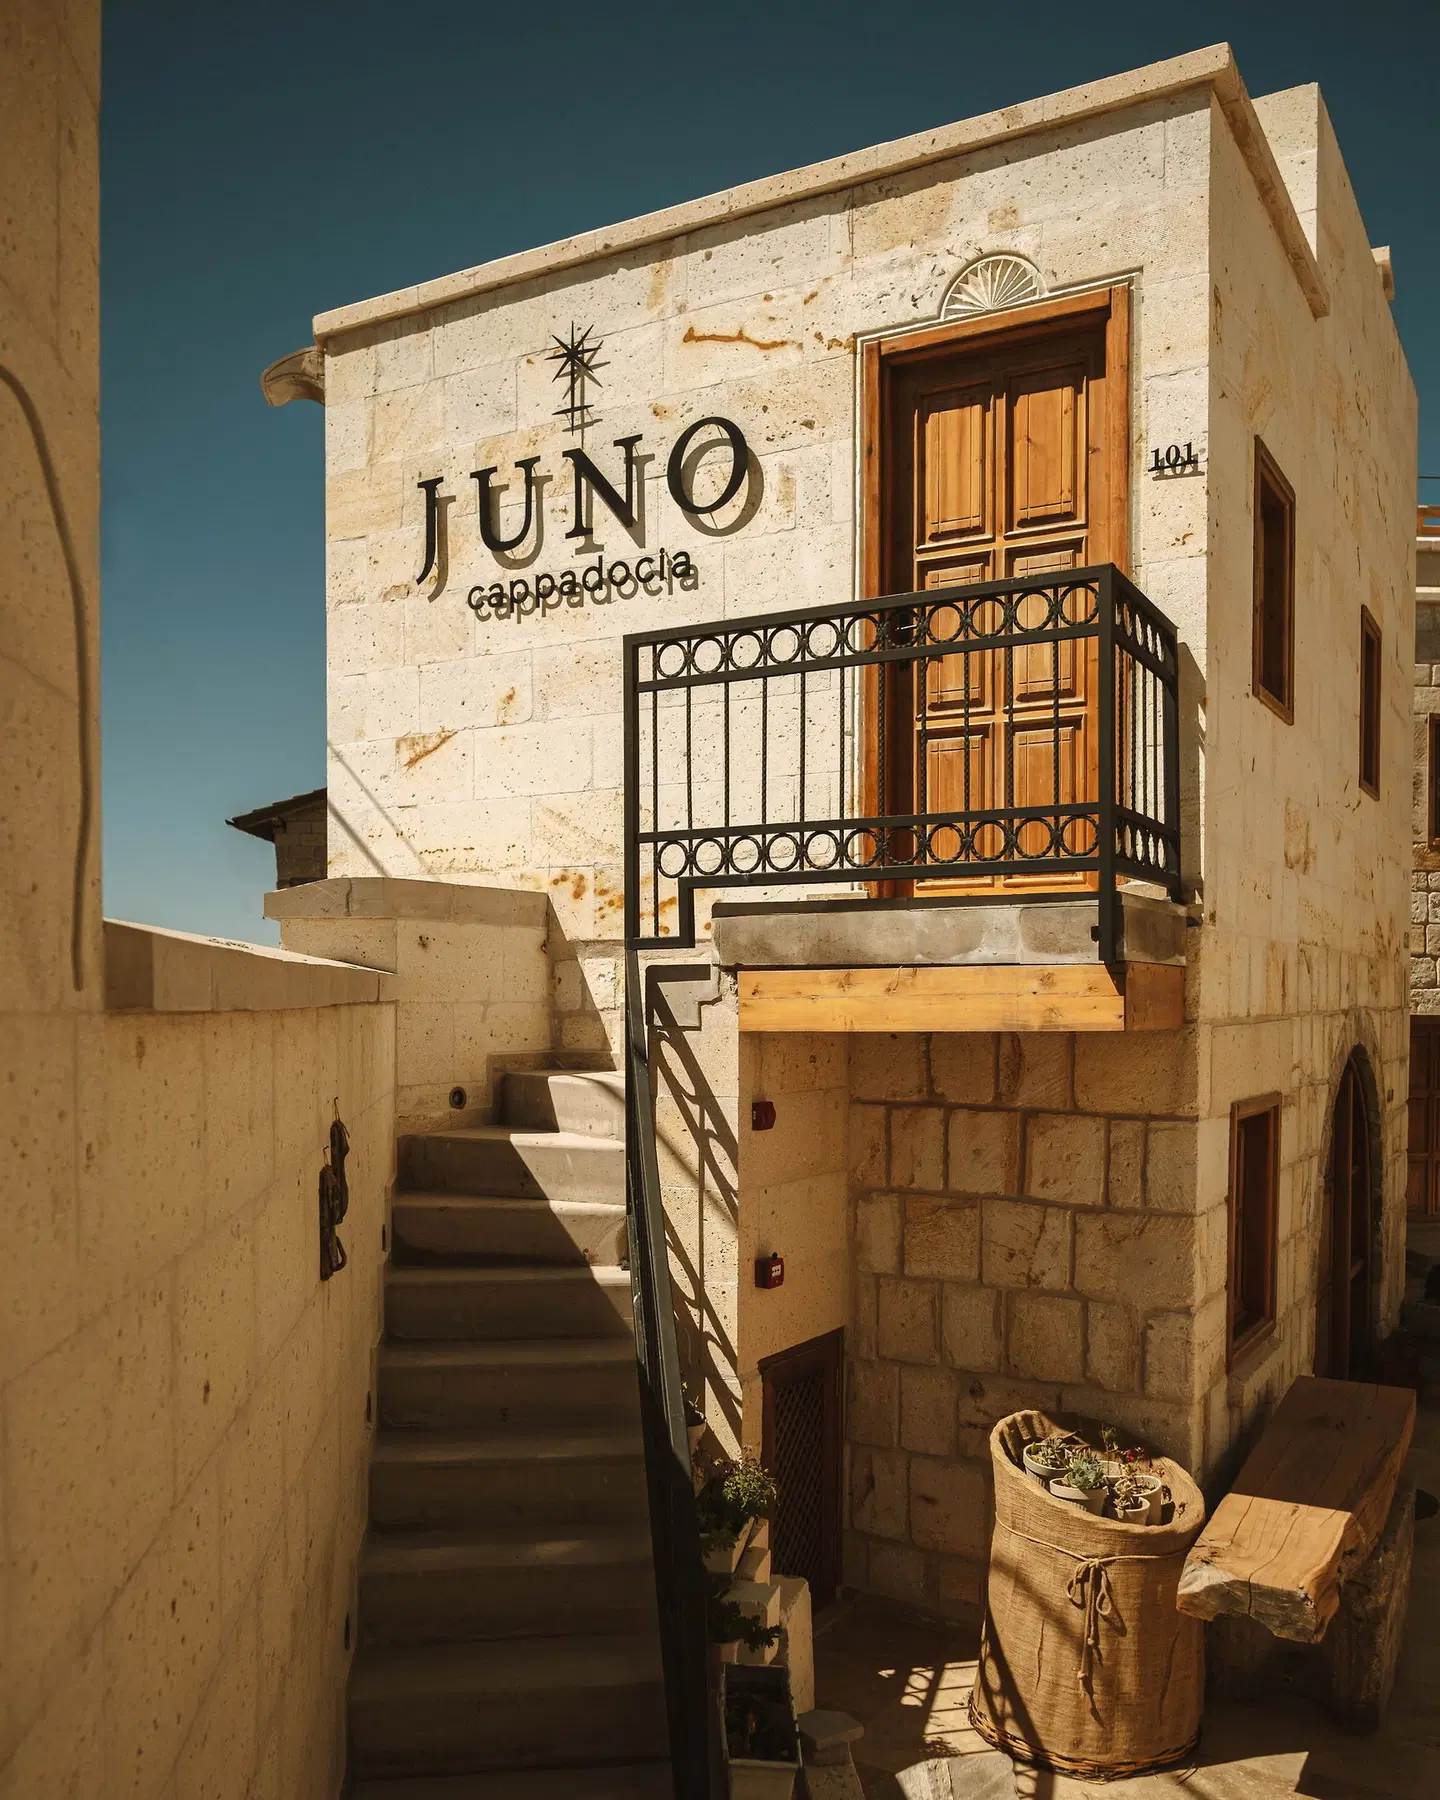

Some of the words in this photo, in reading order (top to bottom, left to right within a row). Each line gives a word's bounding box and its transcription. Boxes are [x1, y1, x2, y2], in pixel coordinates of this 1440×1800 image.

[1149, 442, 1197, 471] 101
[416, 416, 749, 585] JUNO
[467, 547, 692, 613] cappadocia
